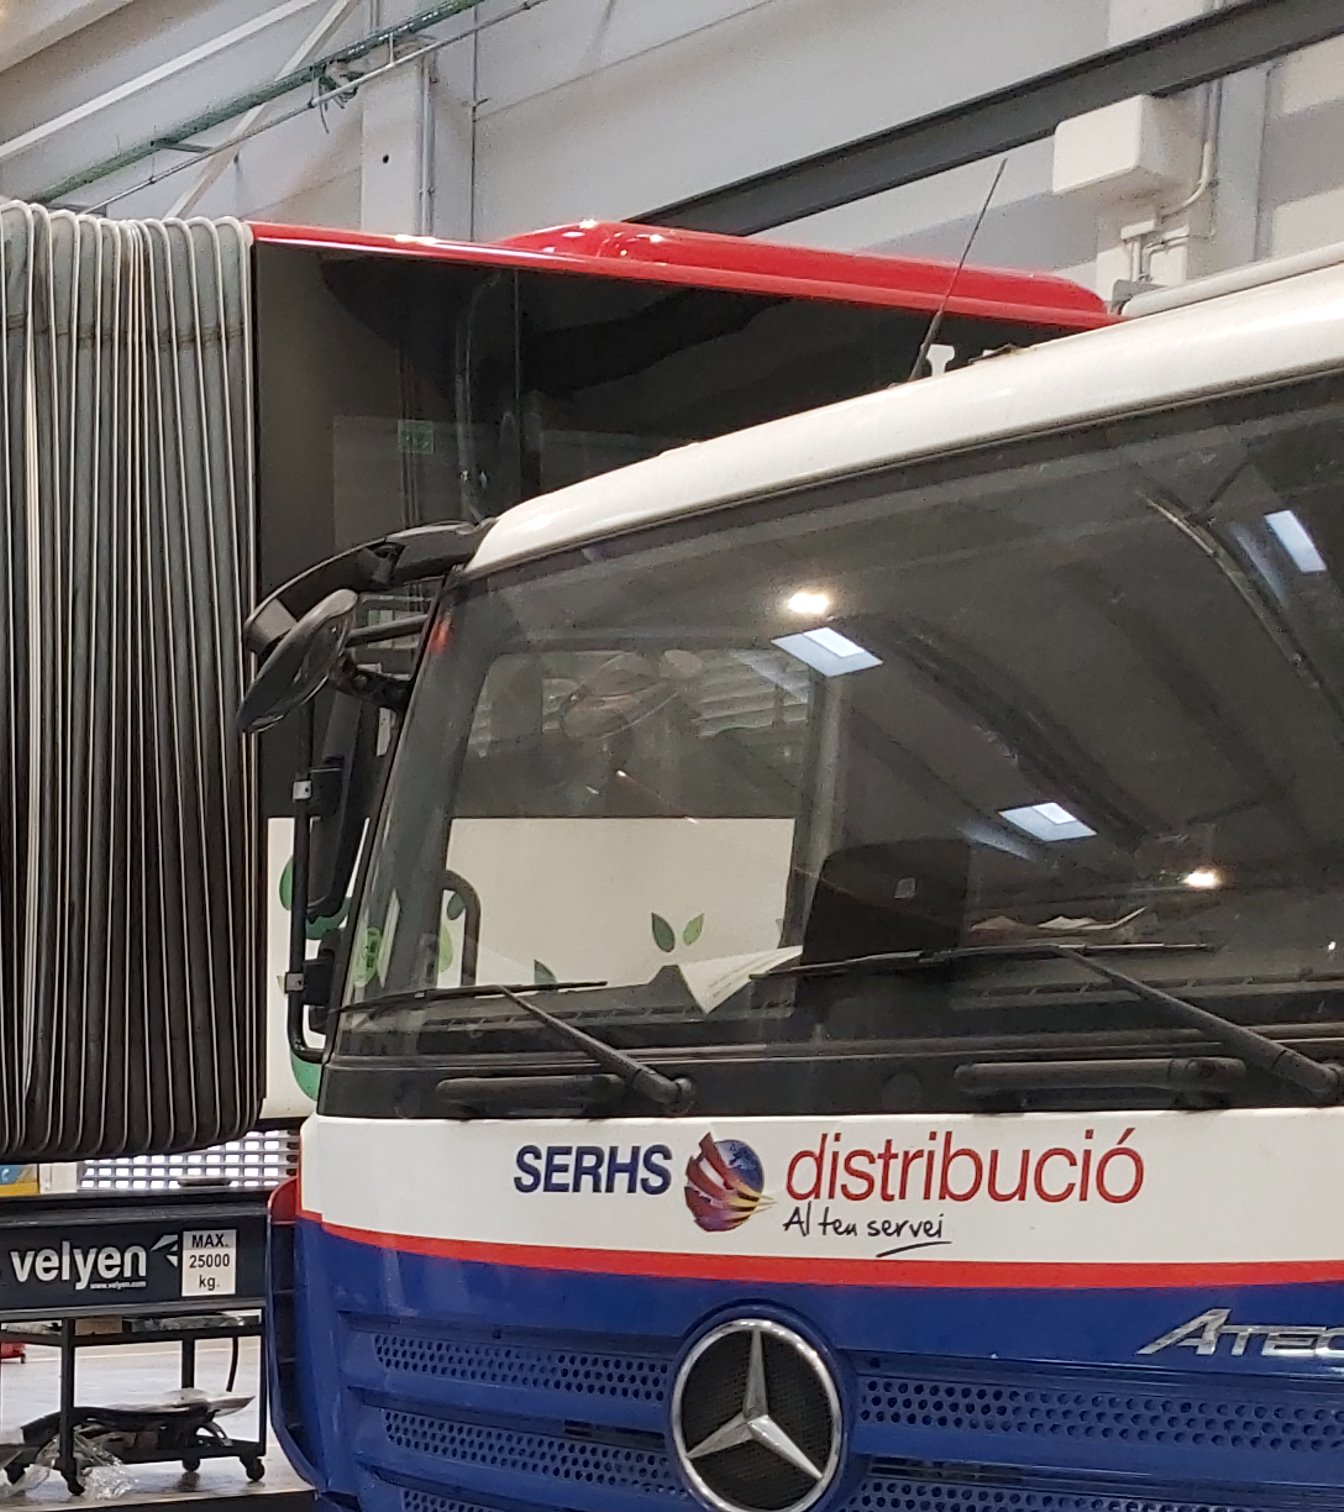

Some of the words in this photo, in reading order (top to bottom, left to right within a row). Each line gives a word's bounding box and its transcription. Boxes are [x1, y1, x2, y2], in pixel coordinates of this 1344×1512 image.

[513, 1143, 673, 1196] SERHS
[785, 1126, 1147, 1206] distribució
[782, 1200, 813, 1237] Al
[818, 1206, 858, 1237] teu
[866, 1212, 945, 1239] servei
[191, 1232, 230, 1249] MAX.
[9, 1239, 147, 1291] velyen
[188, 1252, 231, 1270] 25000
